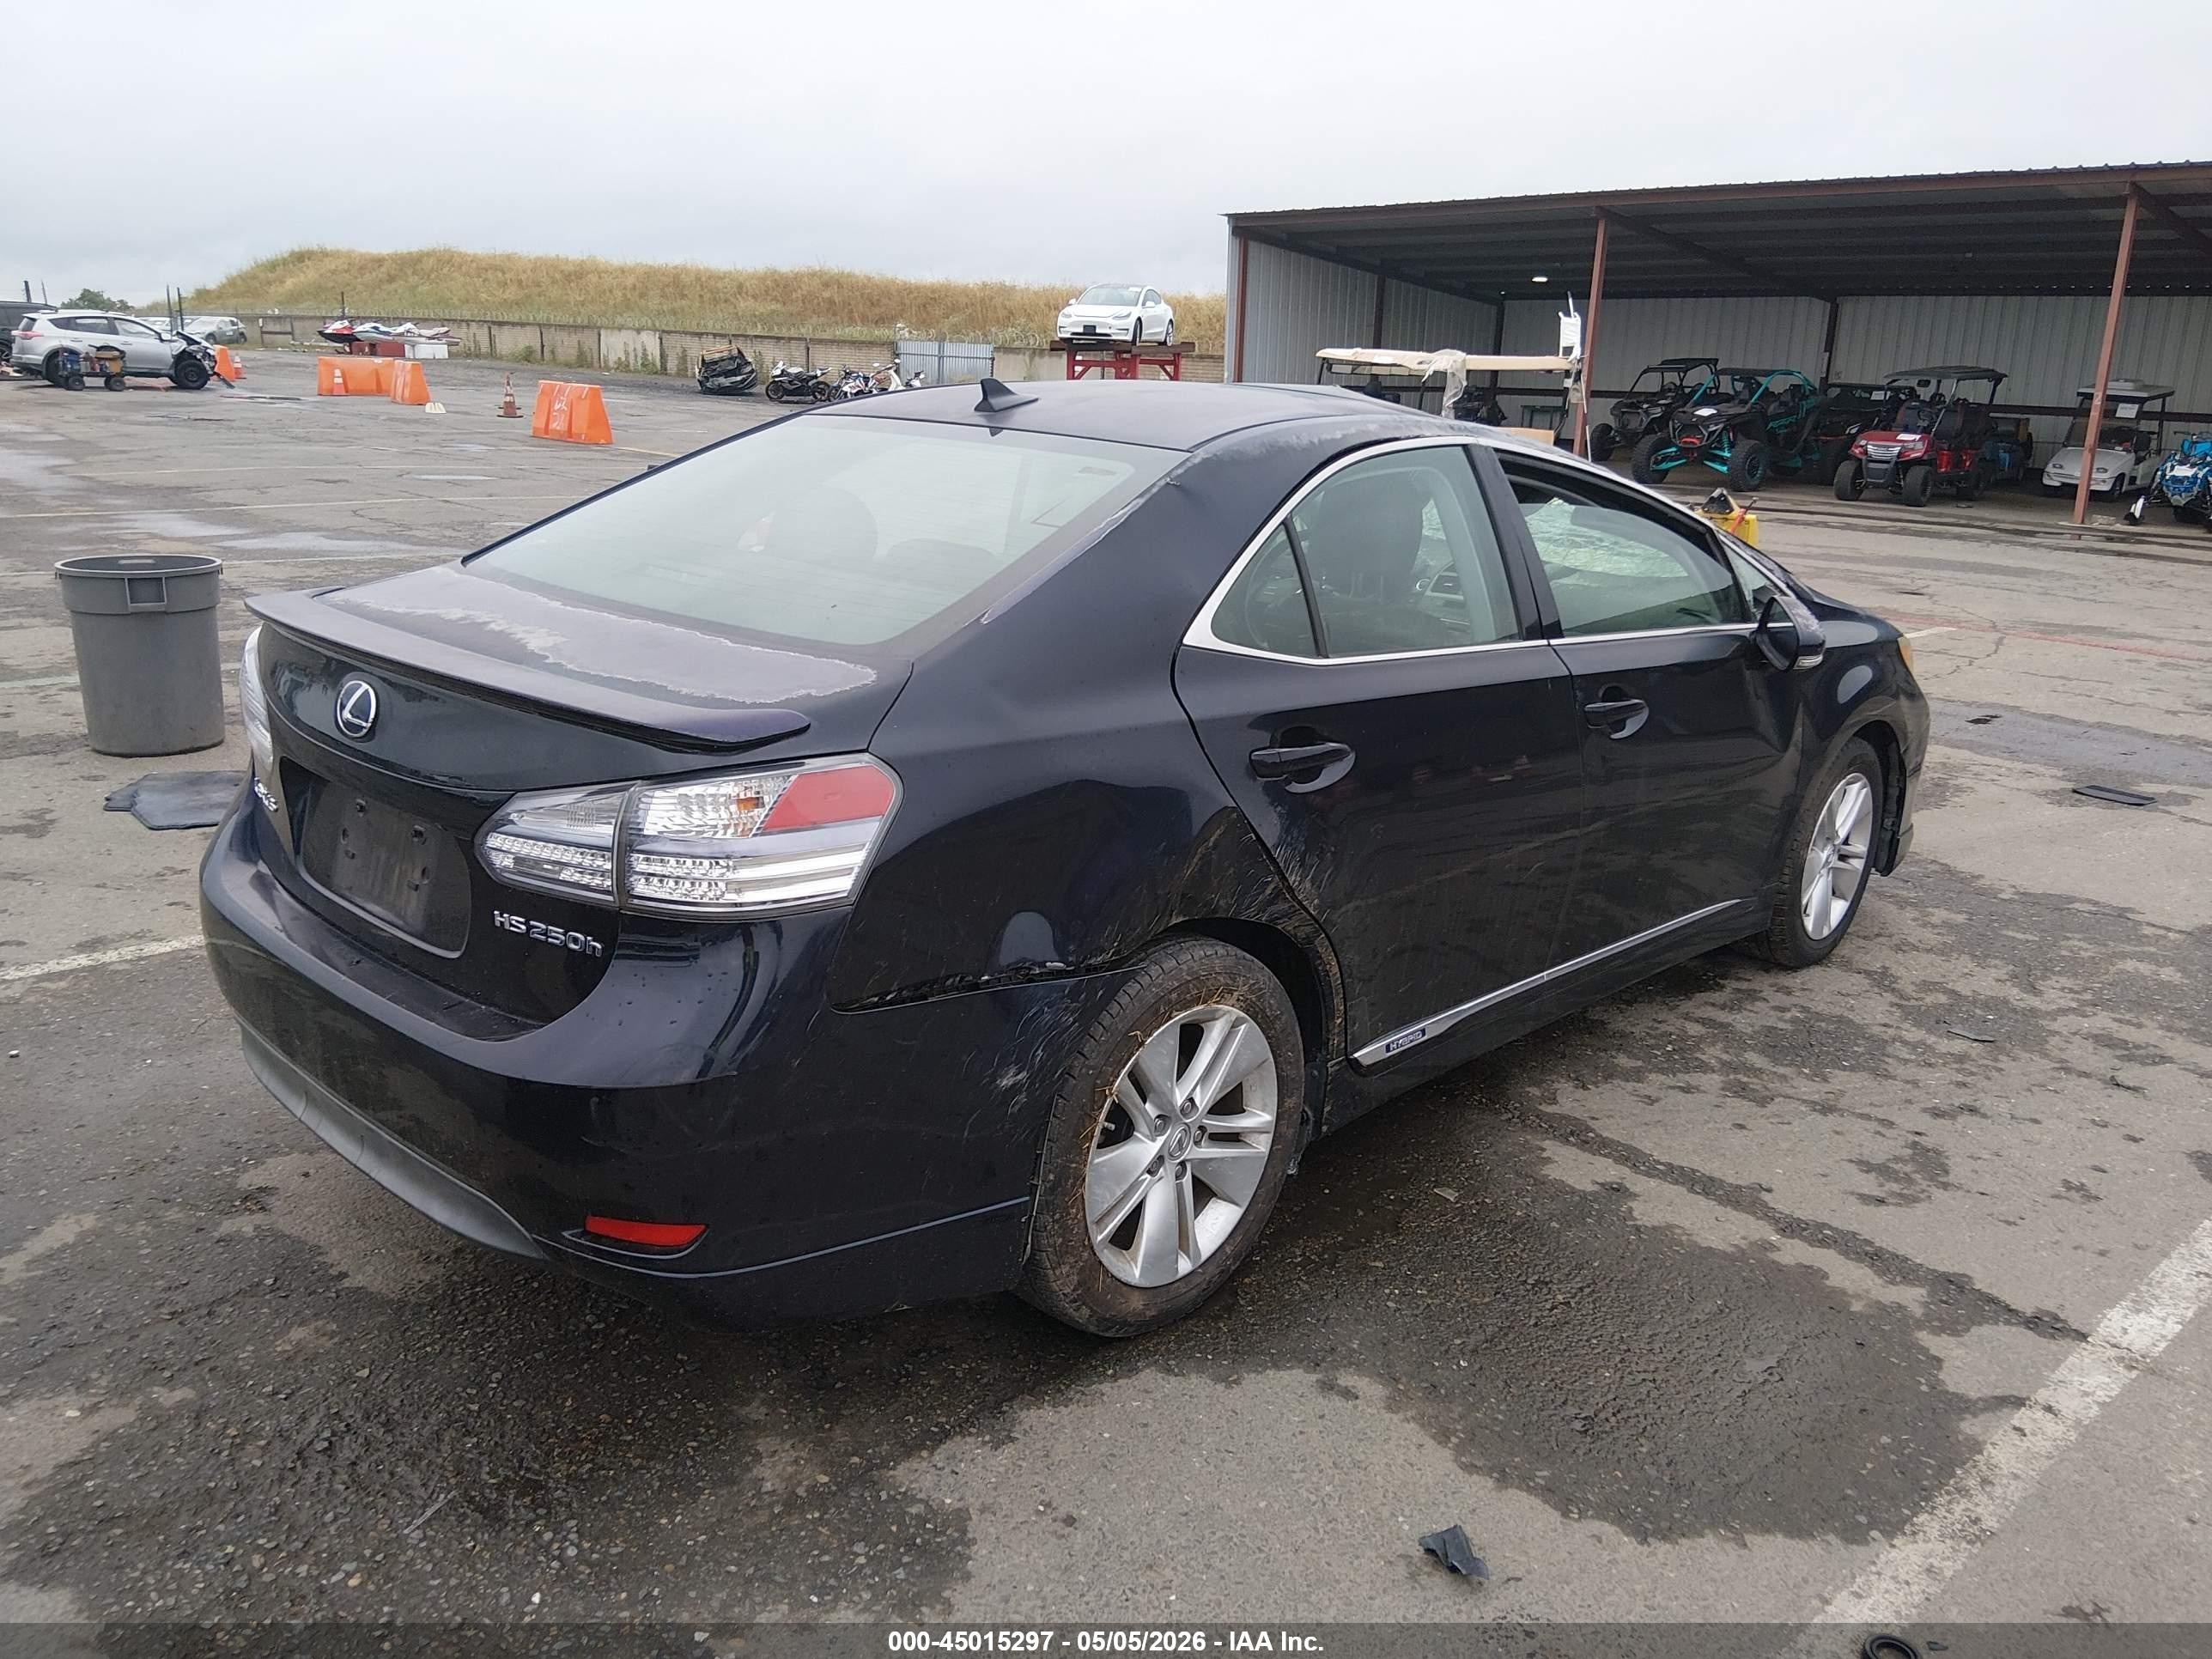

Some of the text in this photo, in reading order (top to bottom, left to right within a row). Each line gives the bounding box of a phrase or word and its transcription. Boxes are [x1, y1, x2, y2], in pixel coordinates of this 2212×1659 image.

[494, 910, 603, 957] HS 250h
[1389, 1030, 1423, 1051] HYBRID
